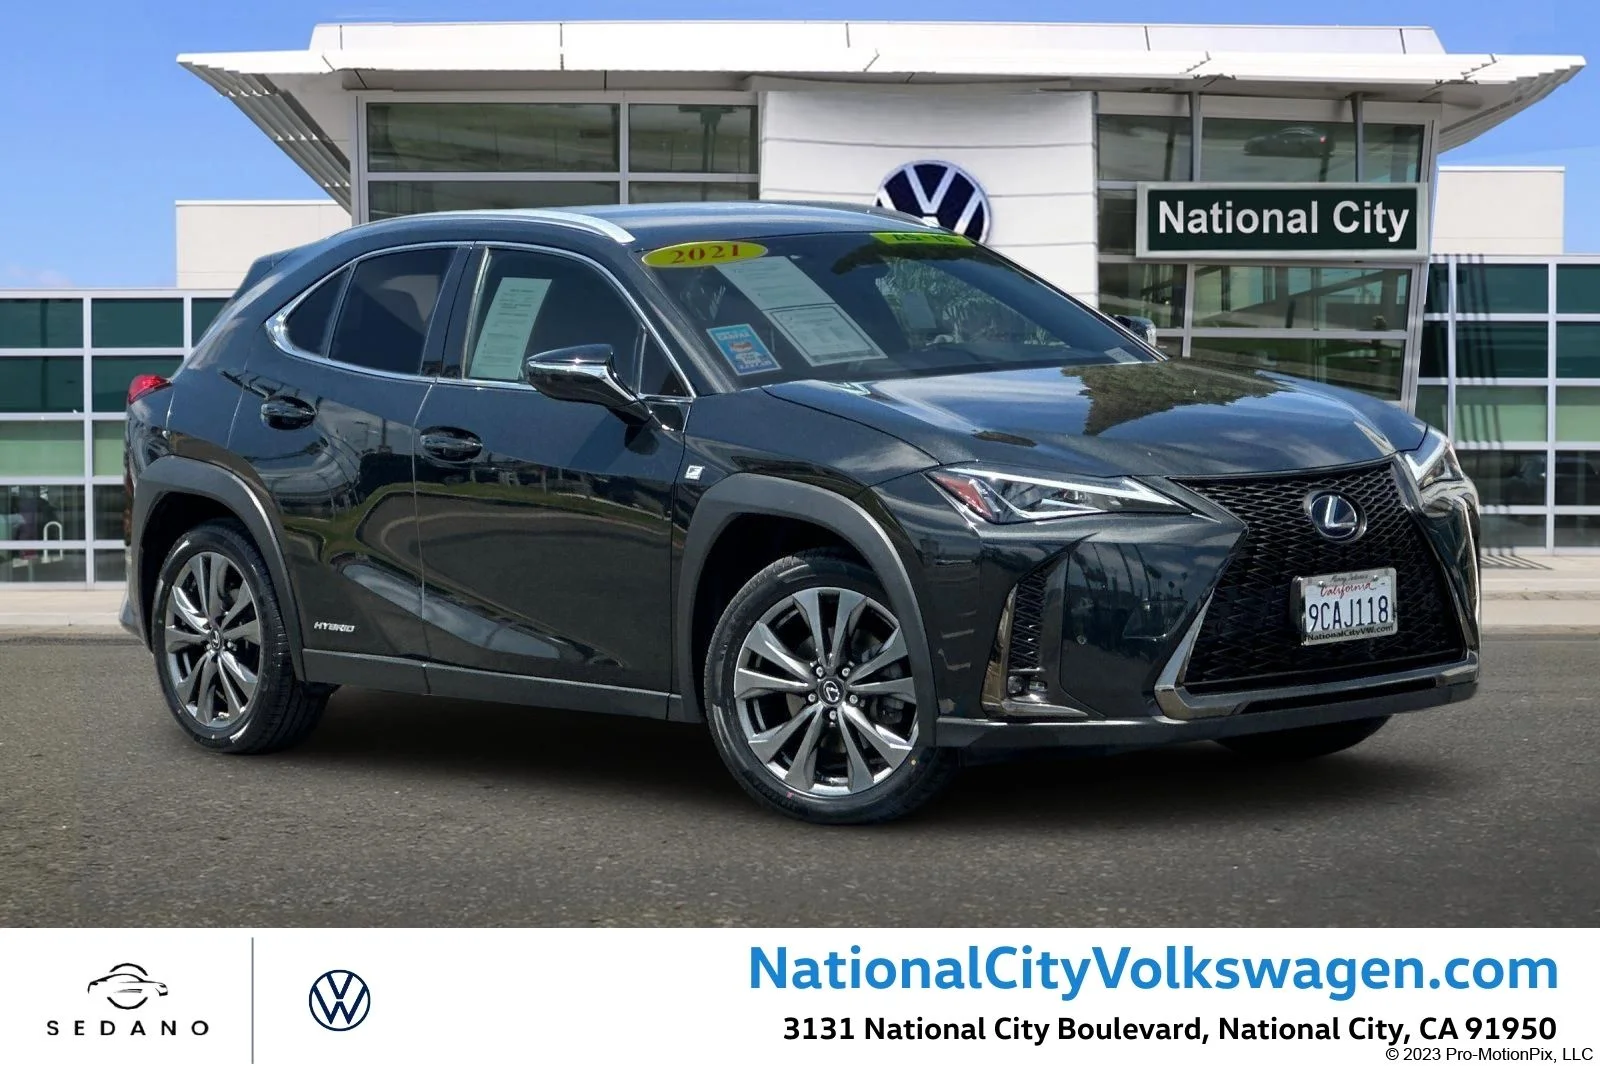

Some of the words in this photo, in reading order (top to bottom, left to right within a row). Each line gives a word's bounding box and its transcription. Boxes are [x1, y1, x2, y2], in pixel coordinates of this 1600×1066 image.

[1159, 200, 1318, 234] National
[1333, 200, 1410, 243] City
[671, 244, 740, 264] 2021
[1320, 581, 1377, 599] California
[1308, 595, 1388, 632] 9CAJ118
[313, 621, 355, 633] HYBRID
[1308, 624, 1394, 641] NationalCityVW.com
